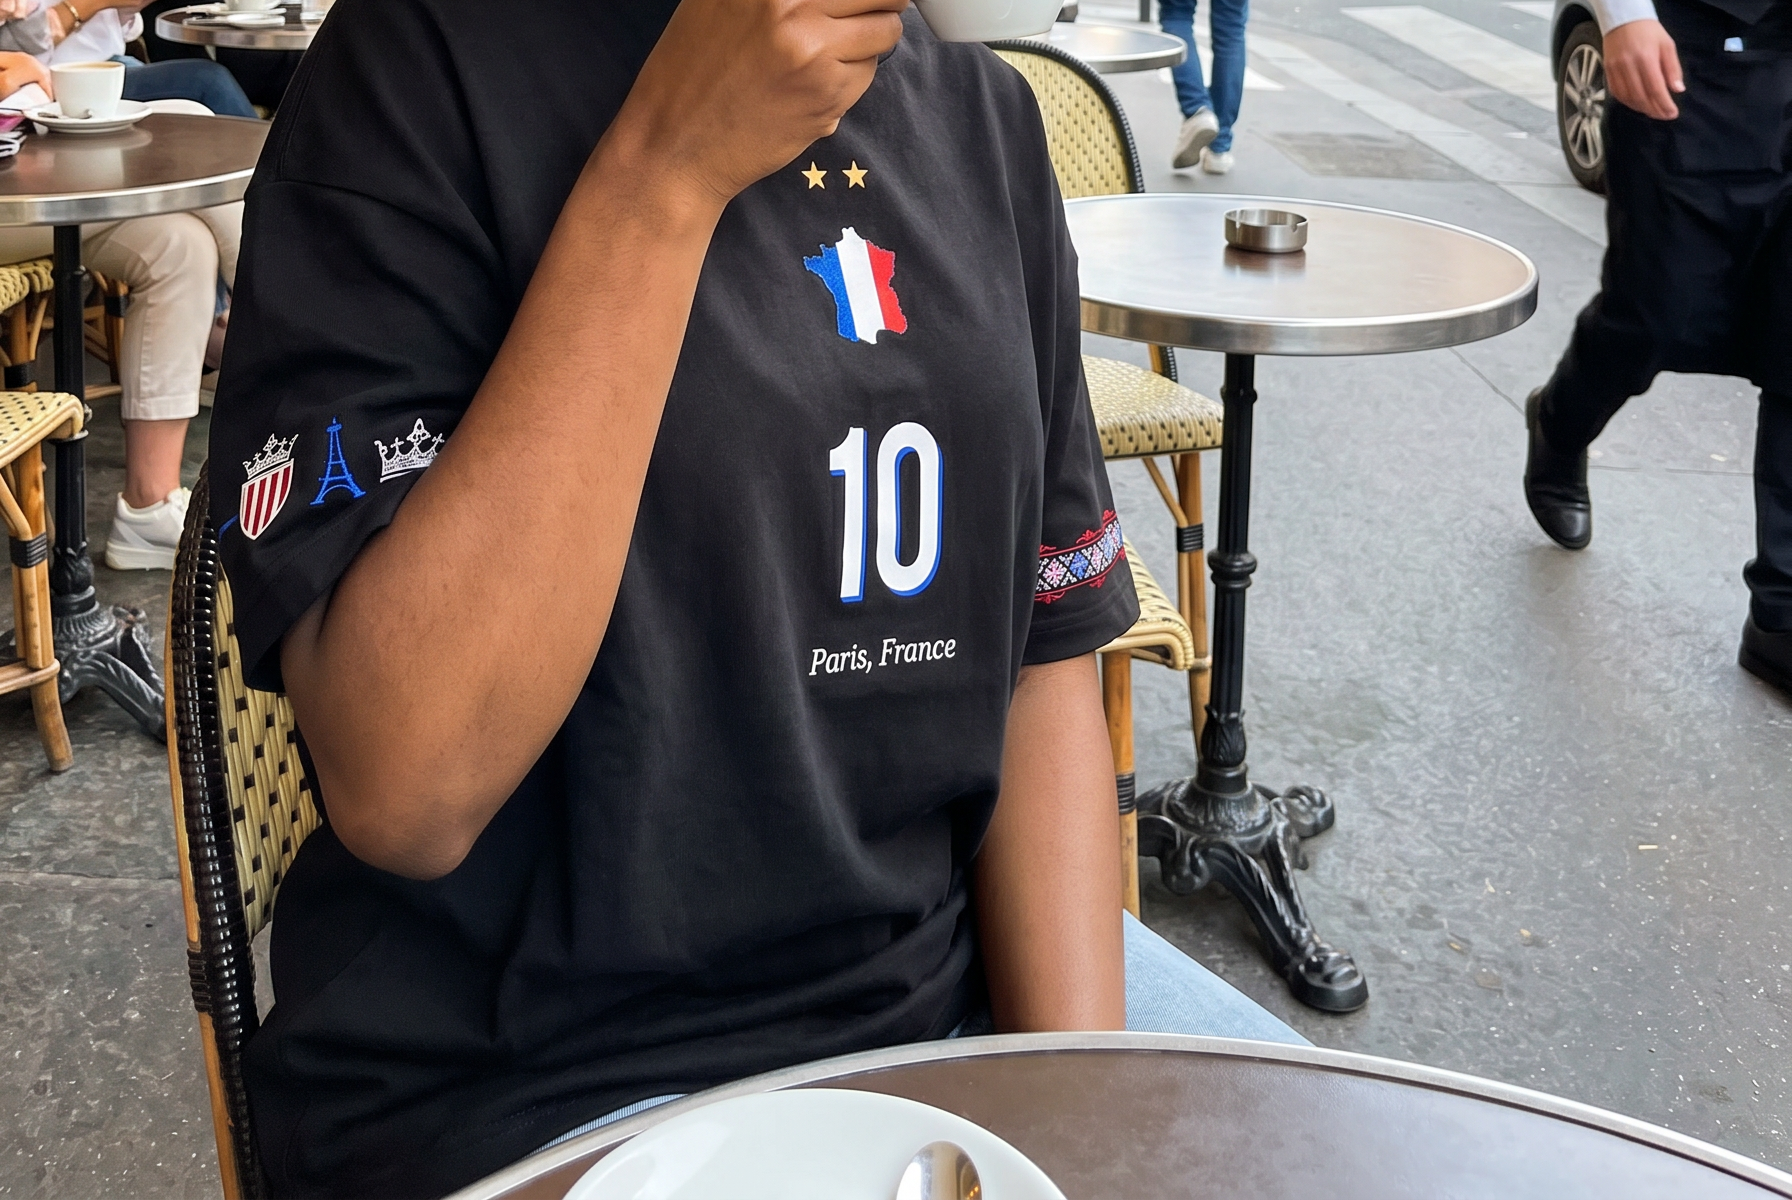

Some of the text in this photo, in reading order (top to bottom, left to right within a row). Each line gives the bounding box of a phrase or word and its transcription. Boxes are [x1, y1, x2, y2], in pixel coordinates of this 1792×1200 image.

[829, 421, 944, 603] 10
[808, 638, 957, 676] Paris, France
